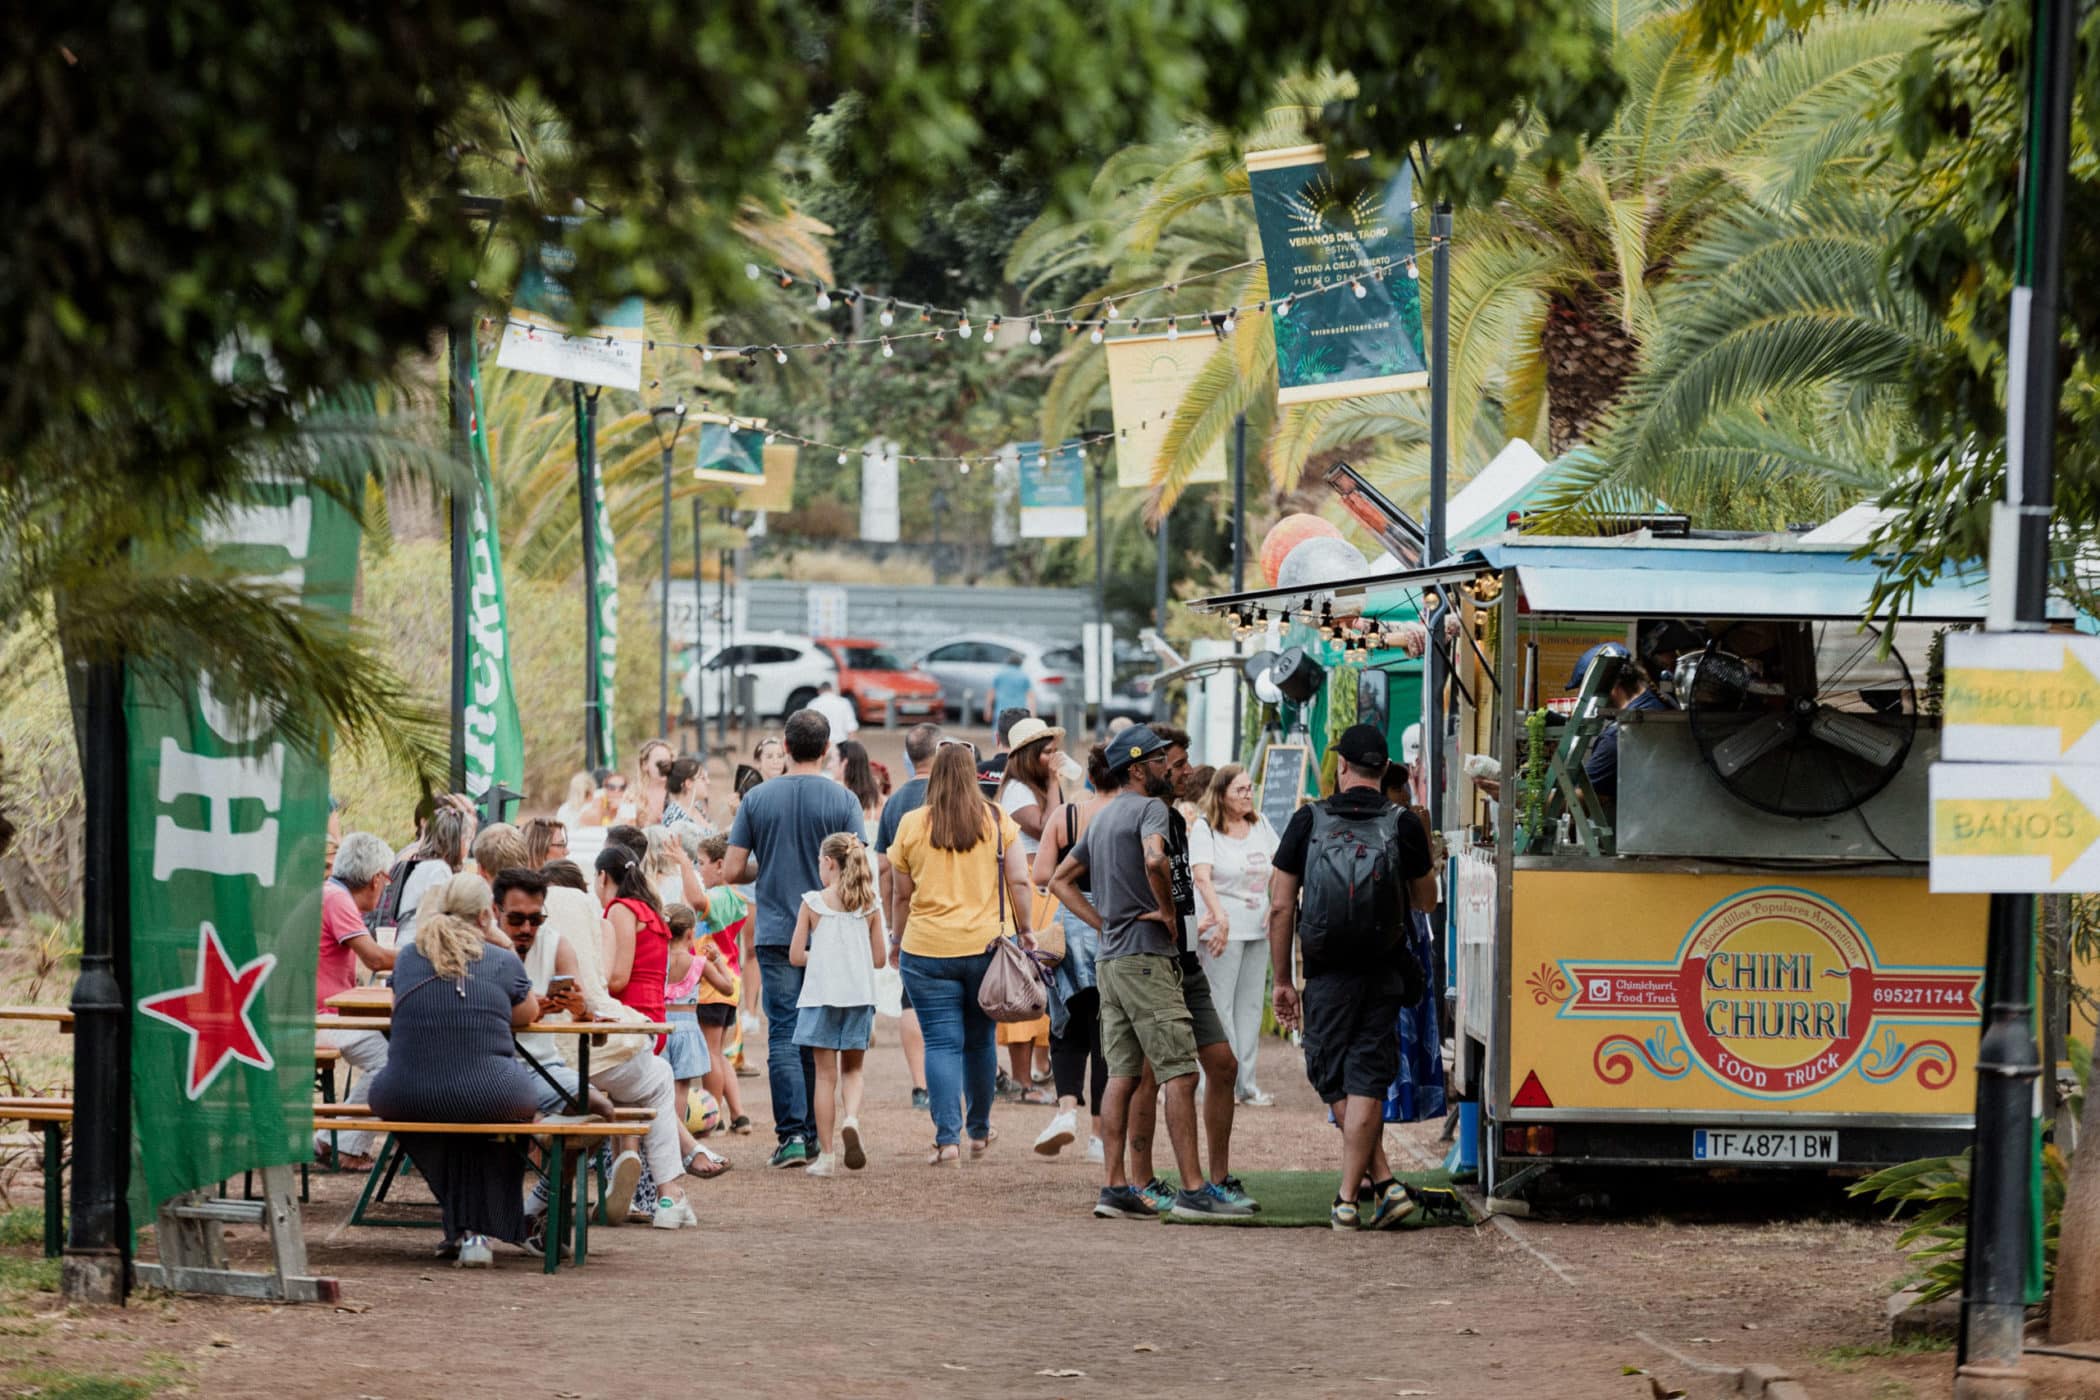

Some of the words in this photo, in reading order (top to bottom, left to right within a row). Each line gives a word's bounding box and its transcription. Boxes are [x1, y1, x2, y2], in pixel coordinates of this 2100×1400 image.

[1289, 233, 1335, 247] VERANOS
[1336, 231, 1356, 242] DEL
[1358, 227, 1389, 240] TAORO
[1293, 264, 1323, 275] TEATRO
[1324, 263, 1331, 272] A
[1332, 260, 1356, 270] CIELO
[1358, 256, 1391, 268] ABIERTO
[1311, 321, 1390, 336] veranosdeltaoro.com
[1953, 803, 2075, 840] BAÑOS
[1700, 908, 1751, 950] Bocadillos
[1752, 901, 1810, 916] Populares
[1812, 910, 1860, 960] Argentinos
[1615, 991, 1643, 1003] Food
[1646, 992, 1677, 1003] Truck
[1873, 988, 1964, 1004] 695271744
[1703, 999, 1850, 1039] CHURRI
[1718, 1052, 1767, 1087] FOOD
[1784, 1053, 1840, 1088] TRUCK
